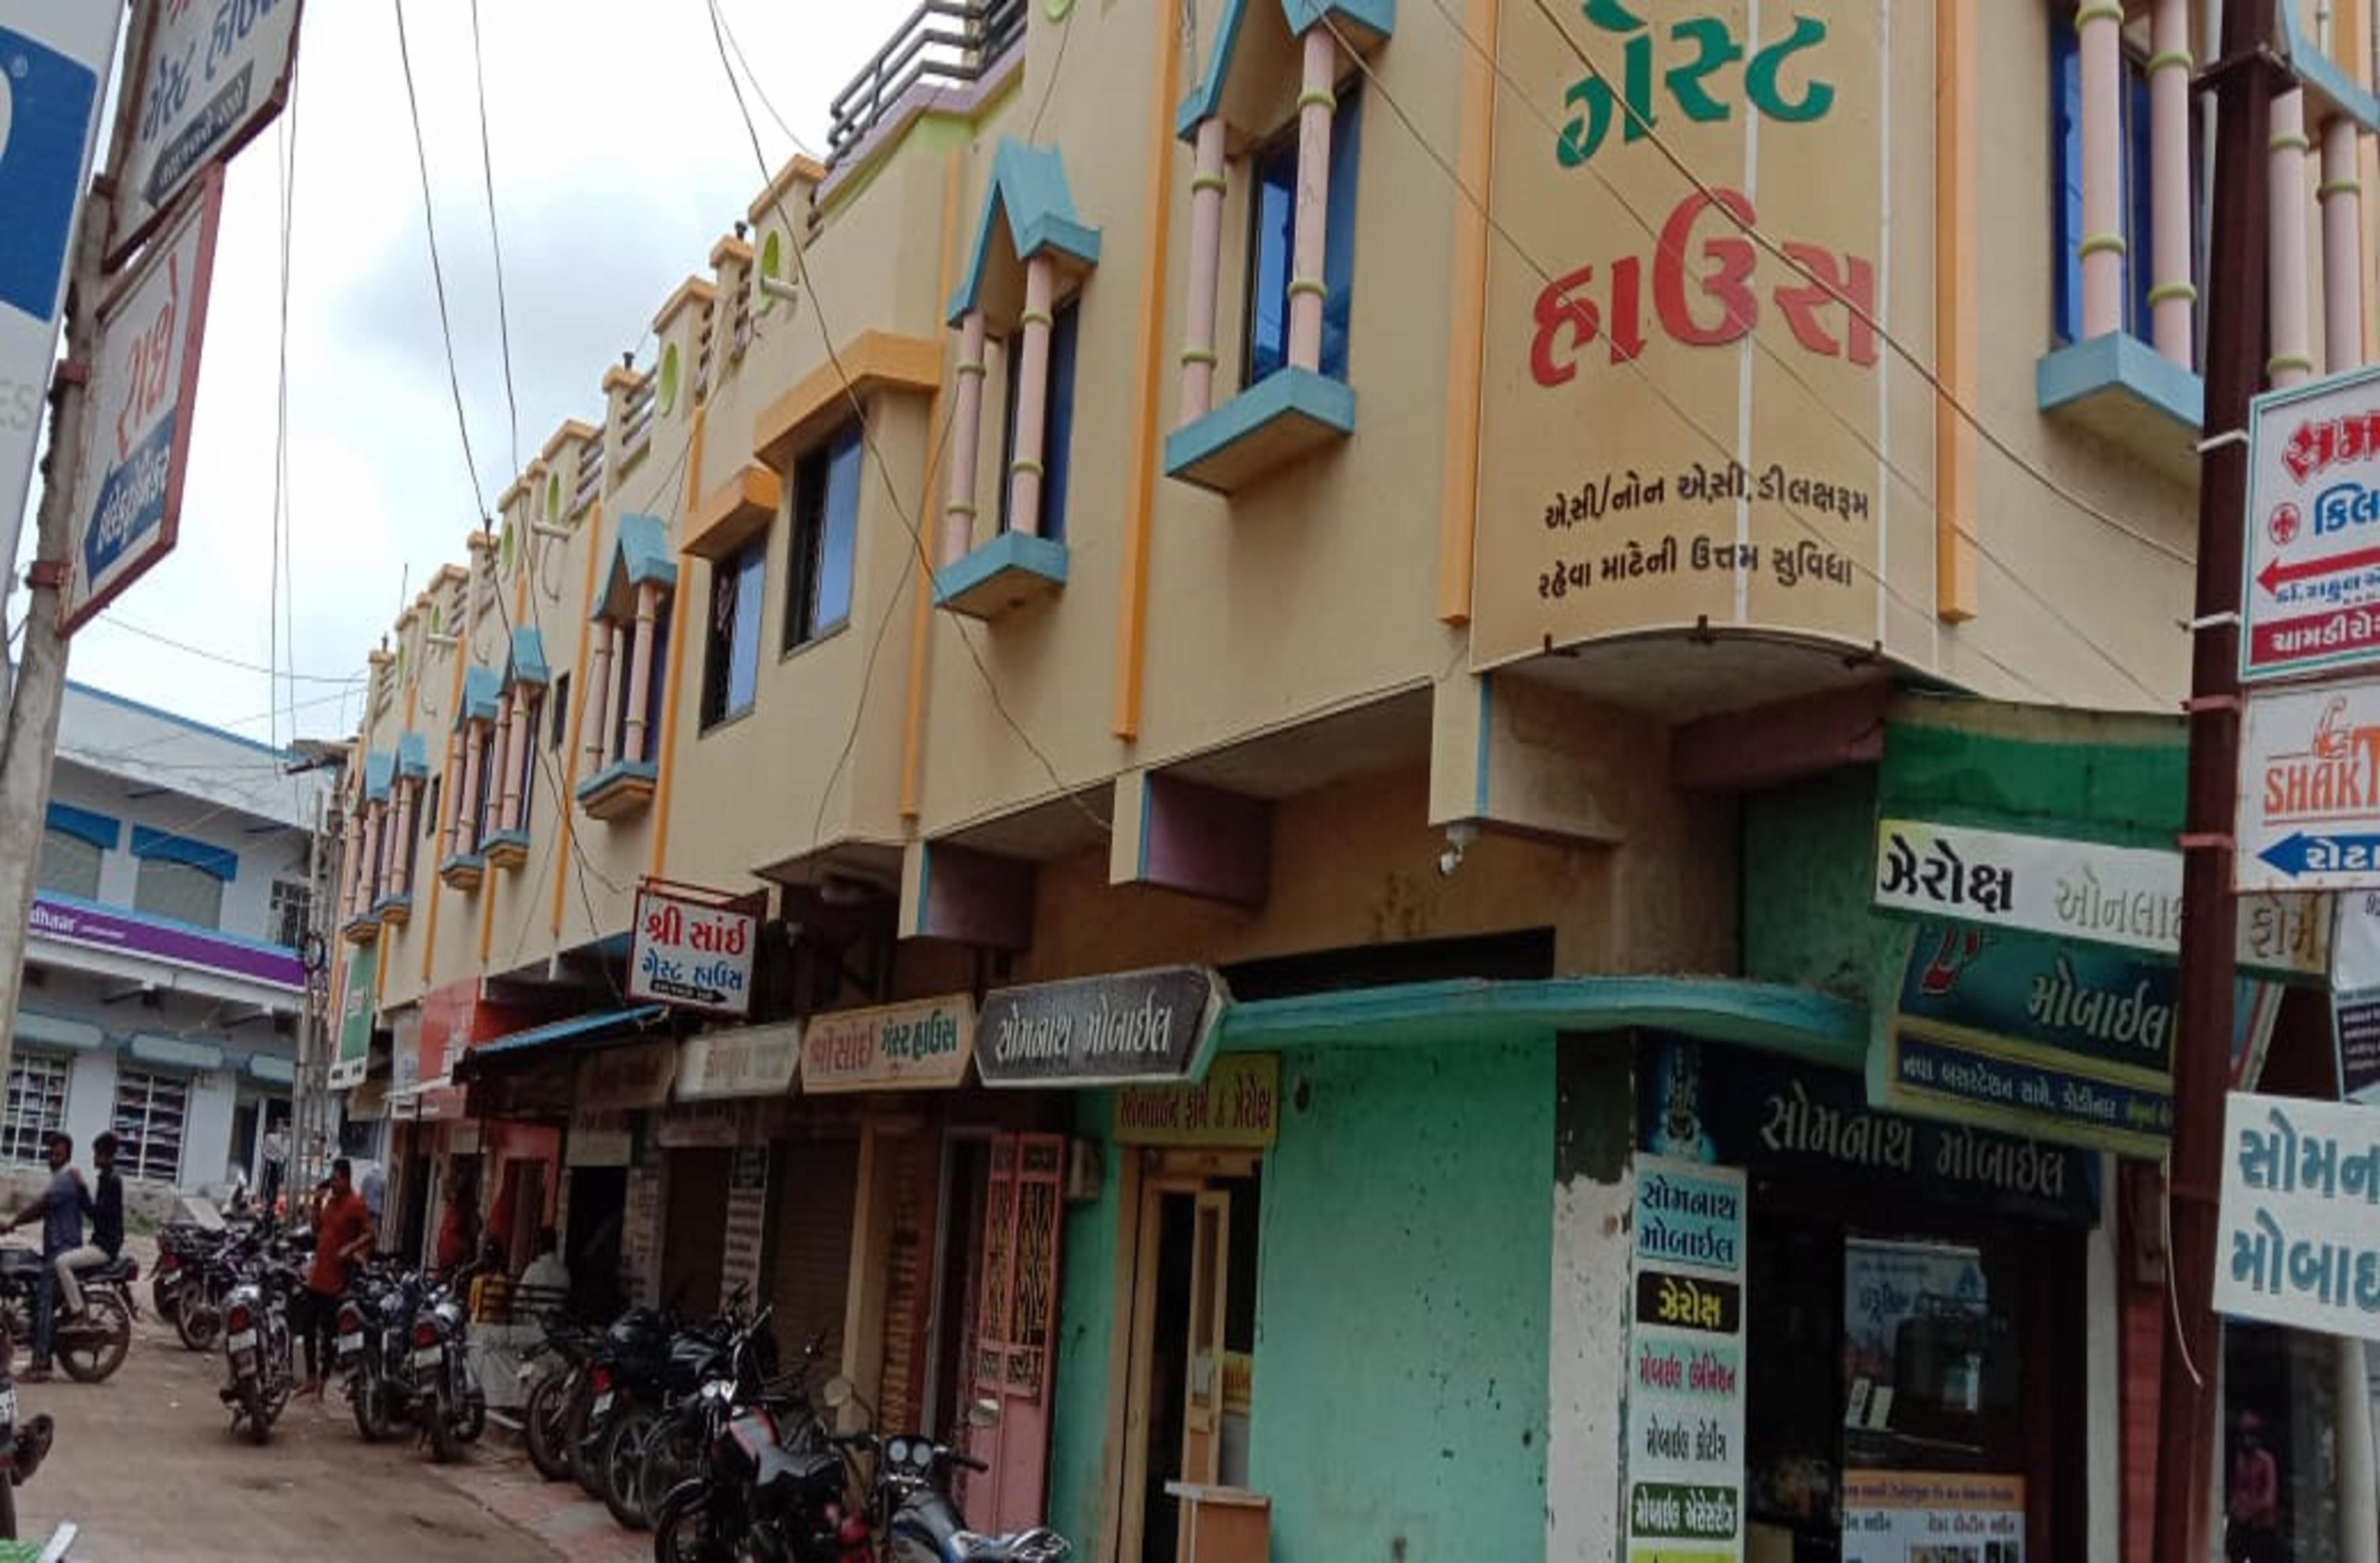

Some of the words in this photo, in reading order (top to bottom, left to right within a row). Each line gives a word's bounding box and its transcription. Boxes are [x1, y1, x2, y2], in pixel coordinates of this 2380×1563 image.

[1556, 0, 1834, 169] ગેસ્ટ
[1529, 188, 1880, 388] હાઉસ
[1538, 560, 1591, 600] રહેવા
[1602, 535, 1677, 581] માટેની
[1691, 535, 1759, 572] ઉત્તમ
[1772, 540, 1852, 587] સુવિધા
[1881, 834, 2012, 912] ઝેરોક્ષ
[646, 903, 682, 946] શ્રી
[642, 947, 682, 980] ગેસ્ટ
[694, 961, 743, 992] હાઉસ
[995, 998, 1072, 1063] સોમનાથ
[1760, 1078, 1914, 1172] સોમનાથ
[1641, 1174, 1737, 1220] સોમનાથ
[1658, 1277, 1721, 1327] ઝેરોક્ષ
